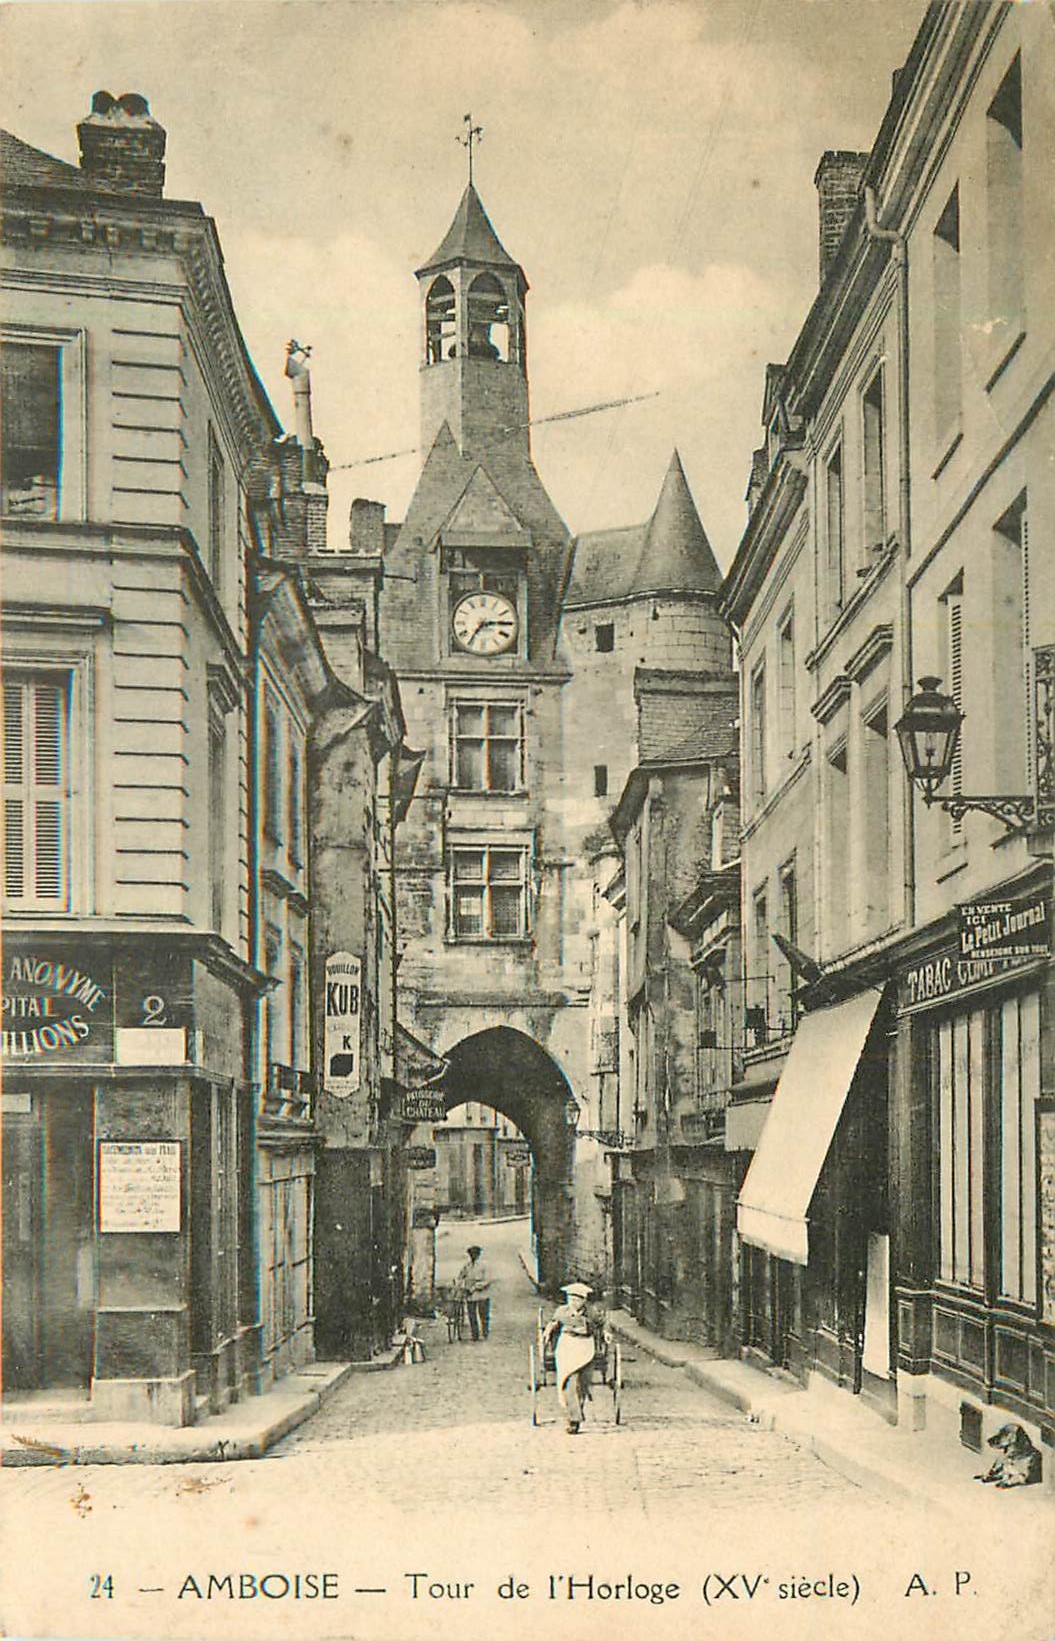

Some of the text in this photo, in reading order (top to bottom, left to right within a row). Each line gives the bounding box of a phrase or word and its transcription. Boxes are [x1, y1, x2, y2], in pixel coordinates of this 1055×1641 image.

[966, 915, 986, 925] ICI
[975, 903, 1012, 914] VENTE
[961, 901, 1046, 954] Le Petit Journal
[908, 957, 951, 1003] TABAC
[143, 995, 166, 1026] 2
[327, 982, 359, 1016] KUB
[343, 1035, 351, 1050] K
